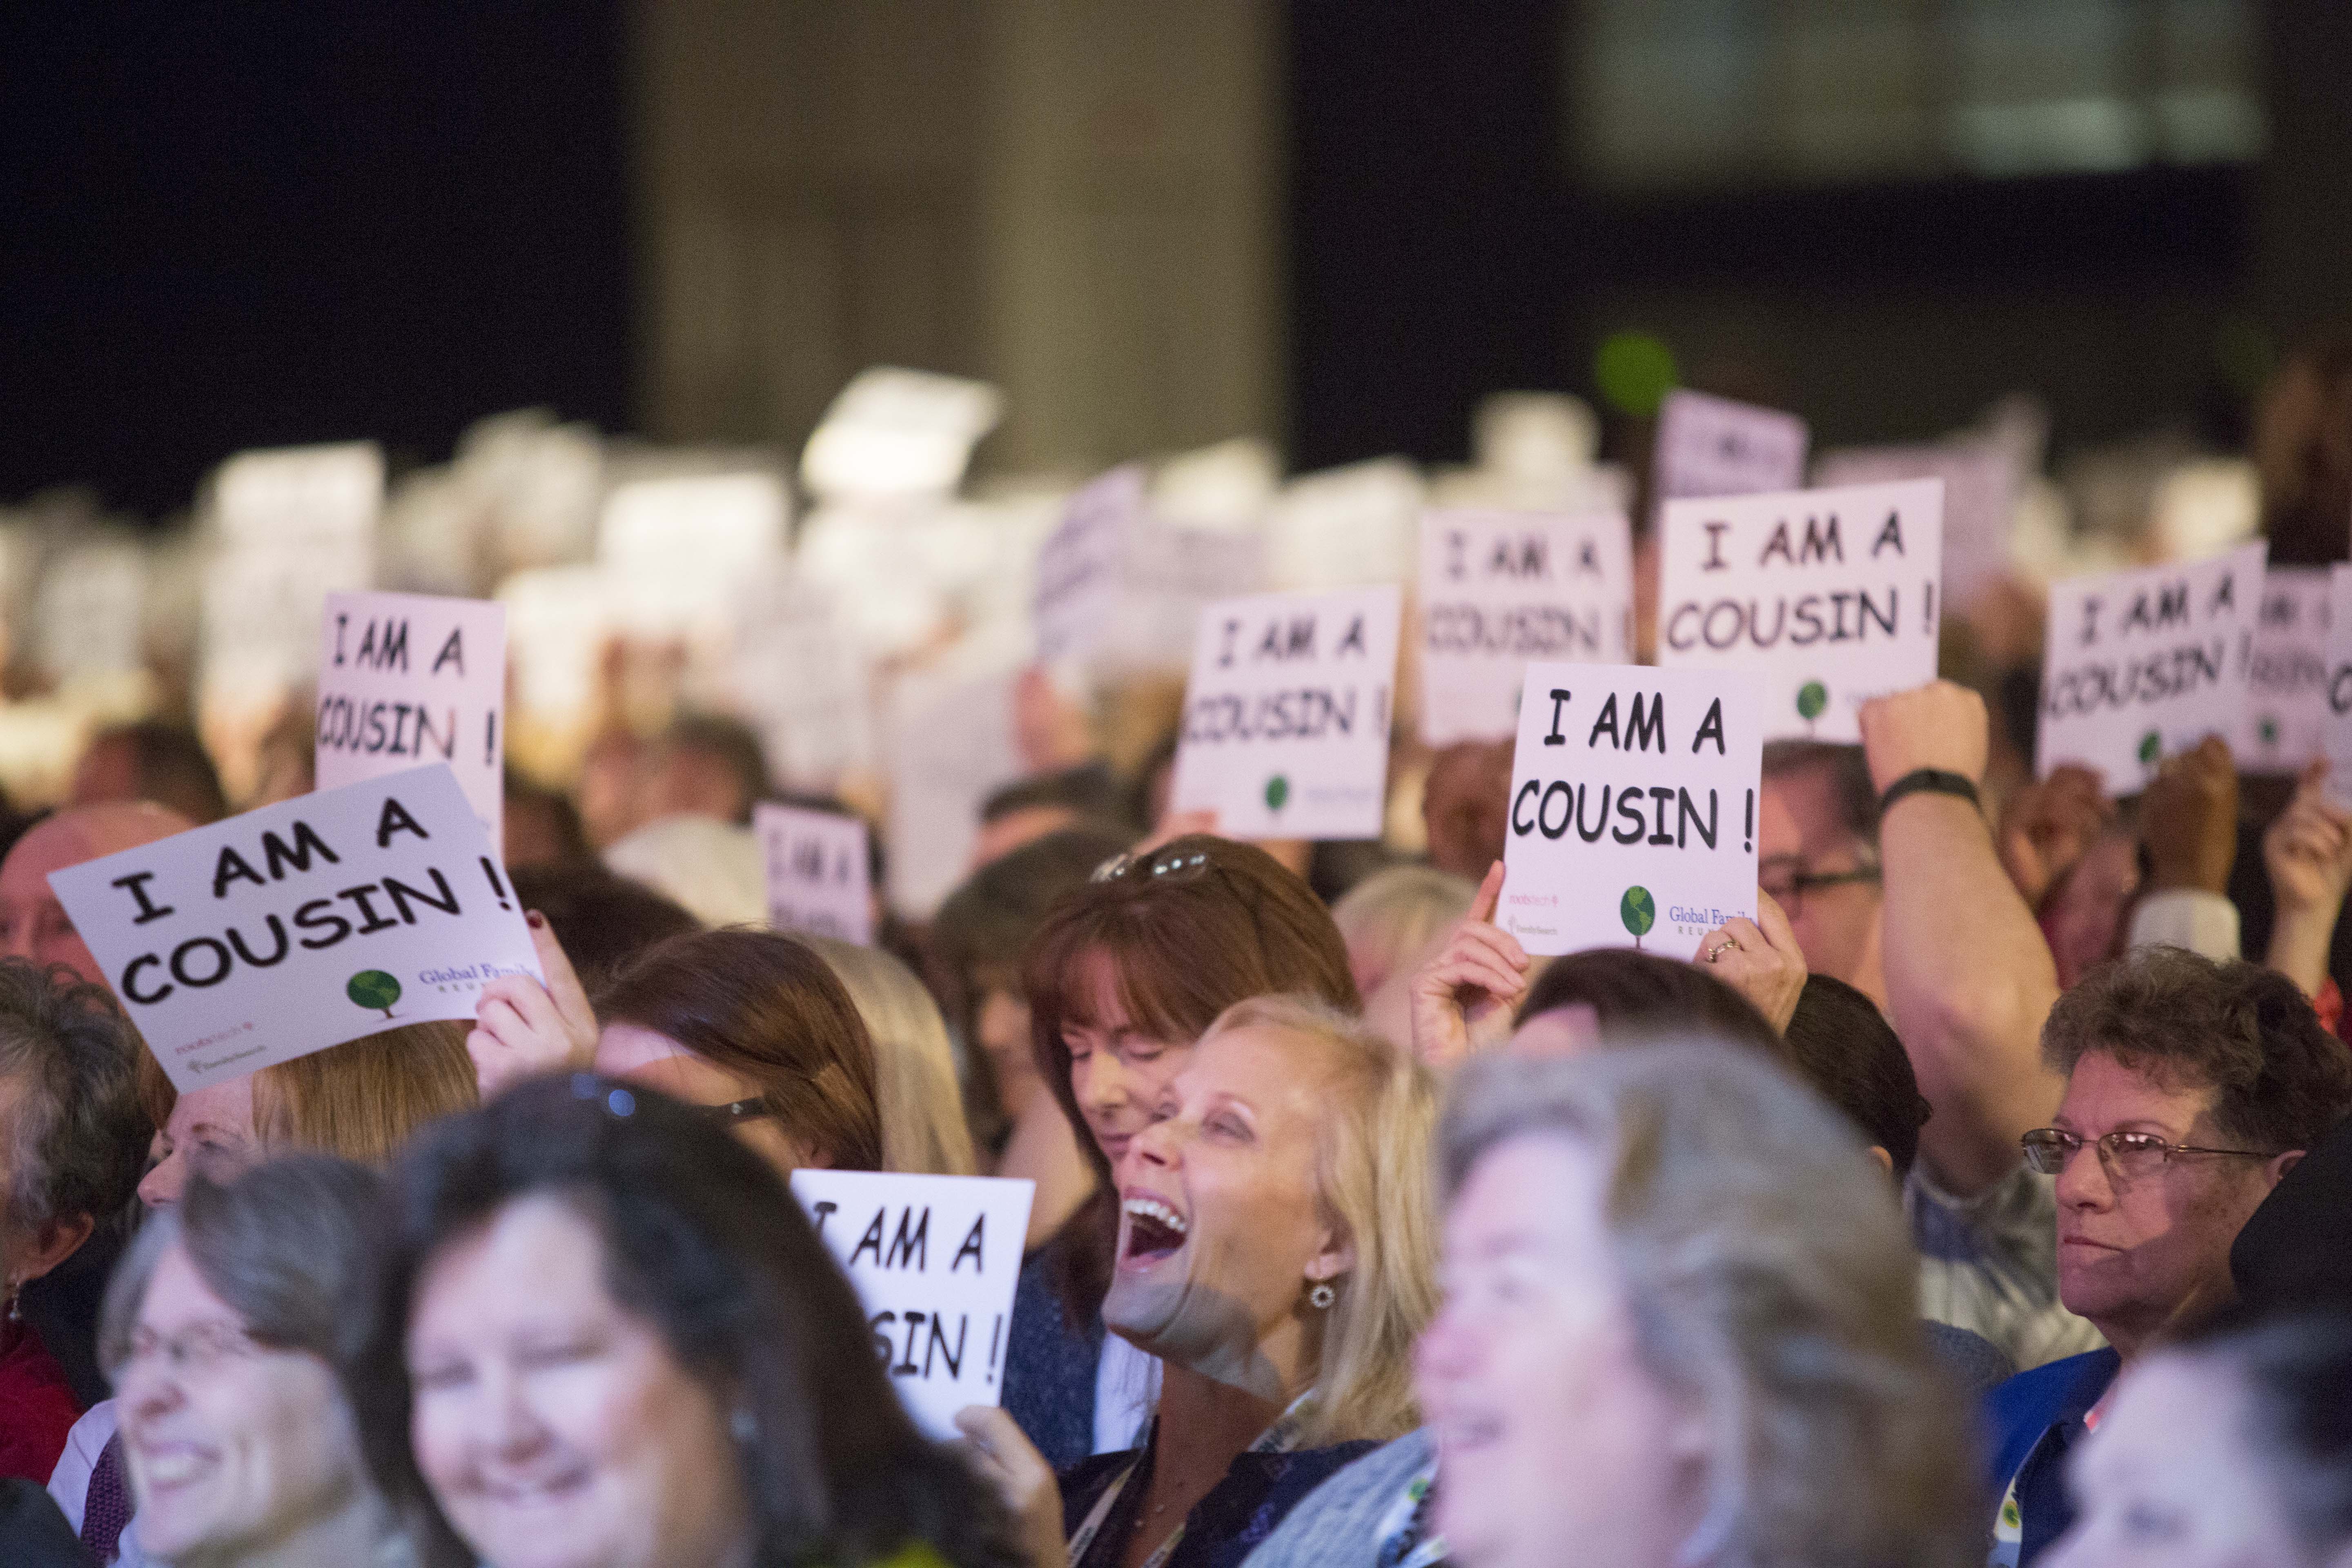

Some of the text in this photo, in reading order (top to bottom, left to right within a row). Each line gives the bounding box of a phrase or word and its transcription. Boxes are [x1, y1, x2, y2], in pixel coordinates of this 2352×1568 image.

[1448, 532, 1603, 581] I AM A
[1701, 508, 1905, 571] I AM A
[1218, 612, 1365, 668] I AM A
[1429, 604, 1600, 654] COUSIN
[1667, 579, 1933, 651] COUSIN !
[2081, 595, 2105, 645] I
[2120, 580, 2189, 637] AM
[2209, 571, 2235, 617] A
[335, 613, 465, 676] I AM A
[2045, 636, 2225, 719] COUSIN
[318, 696, 455, 759] COUSIN
[1191, 687, 1356, 745] COUSIN
[1544, 688, 1726, 755] I AM A
[1512, 779, 1754, 853] COUSIN !
[111, 797, 430, 924] I AM A
[121, 856, 512, 1004] COUSIN !
[1669, 906, 1708, 924] Global
[849, 1206, 931, 1272] AM
[952, 1212, 985, 1274] A
[987, 1313, 1002, 1385] !
